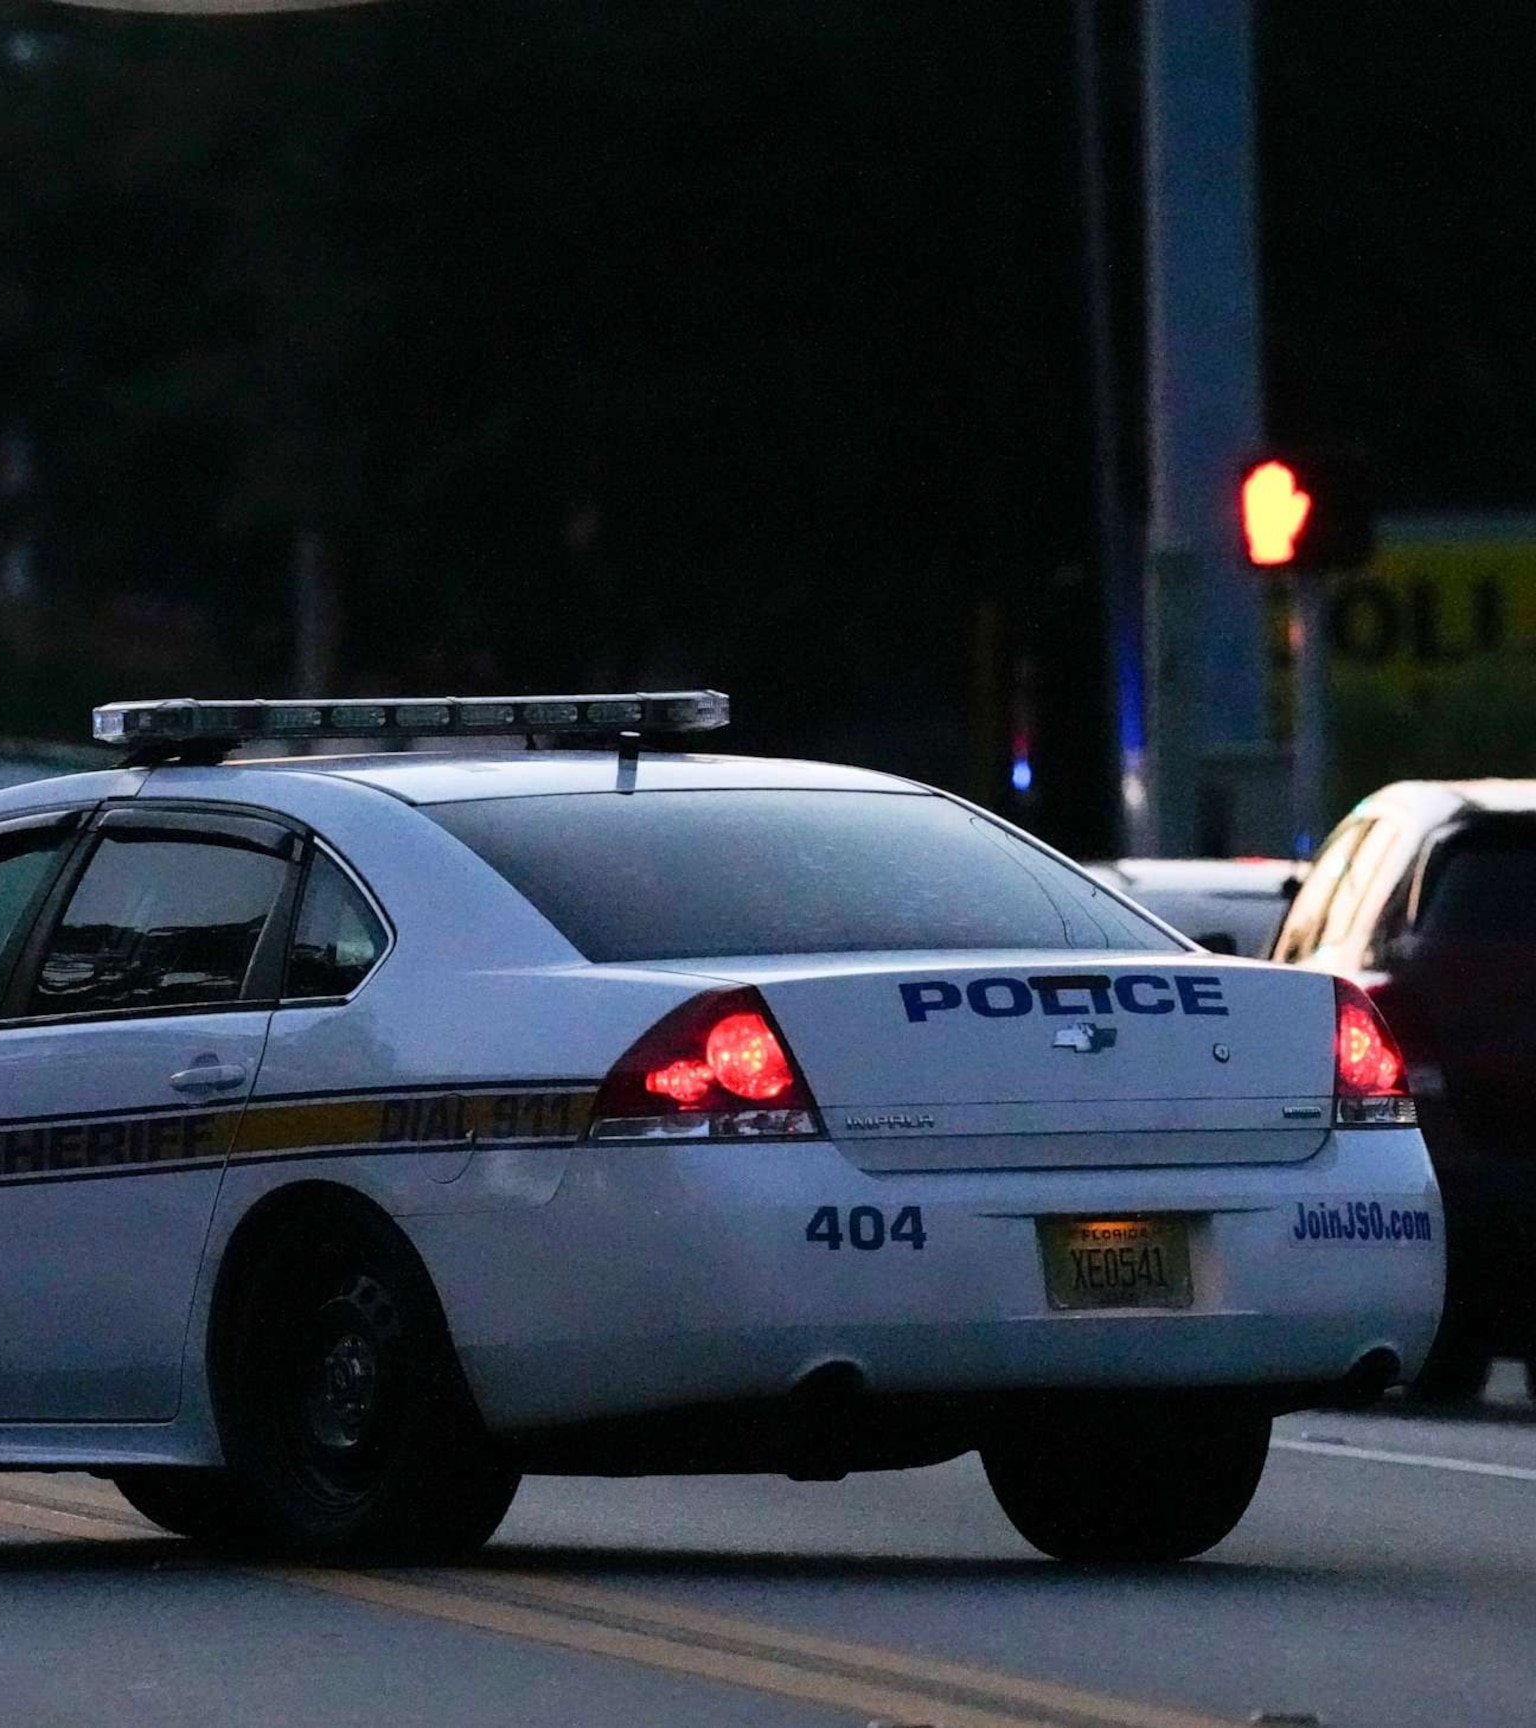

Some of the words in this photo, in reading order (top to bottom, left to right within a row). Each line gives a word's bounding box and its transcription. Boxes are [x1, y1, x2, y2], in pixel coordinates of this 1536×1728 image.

[898, 975, 1230, 1023] POLICE
[381, 1097, 473, 1142] DIAL
[494, 1093, 574, 1139] 911
[845, 1113, 935, 1131] IMPALA
[805, 1205, 928, 1251] 404
[1081, 1228, 1151, 1242] FLORIDA
[1292, 1201, 1434, 1241] JoinJSO.com
[1069, 1246, 1170, 1291] XE0541
